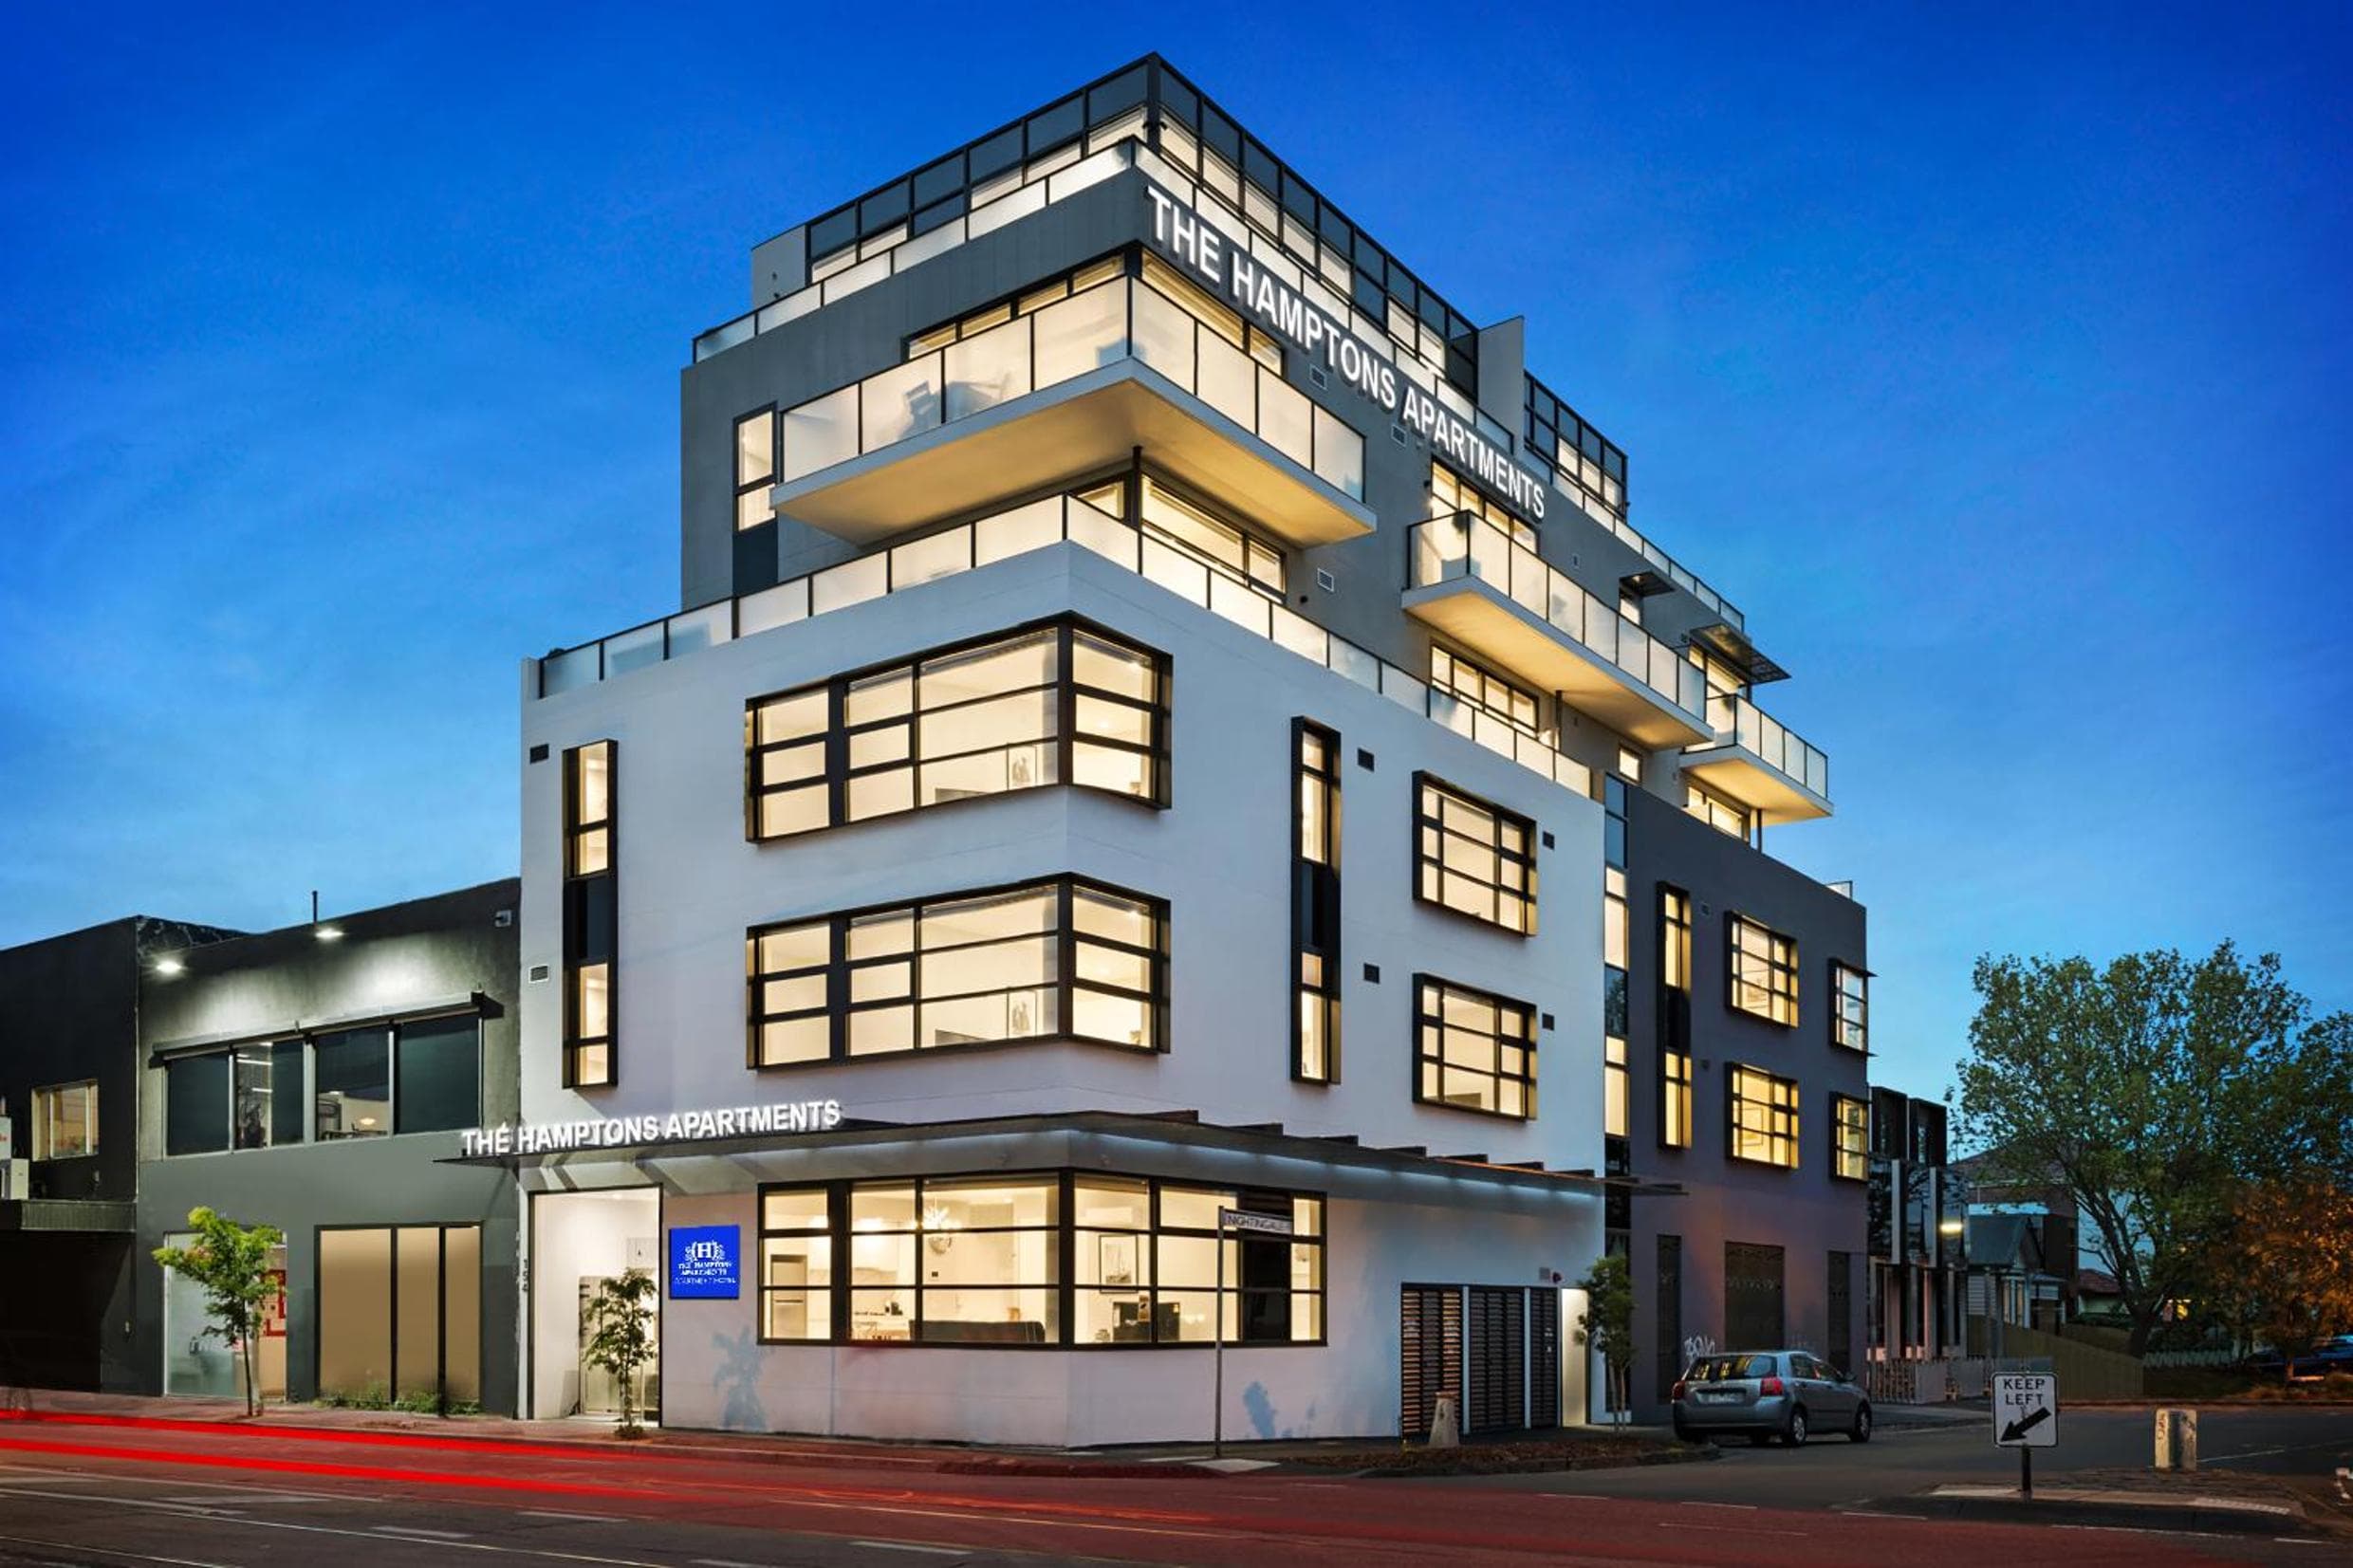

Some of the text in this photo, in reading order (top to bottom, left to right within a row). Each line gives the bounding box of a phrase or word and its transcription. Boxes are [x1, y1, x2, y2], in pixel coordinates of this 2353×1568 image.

[1147, 185, 1546, 519] THE HAMPTONS APARTMENTS
[462, 1099, 841, 1156] THE HAMPTONS APARTMENTS
[2003, 1377, 2046, 1391] KEEP
[2005, 1393, 2044, 1406] LEFT
